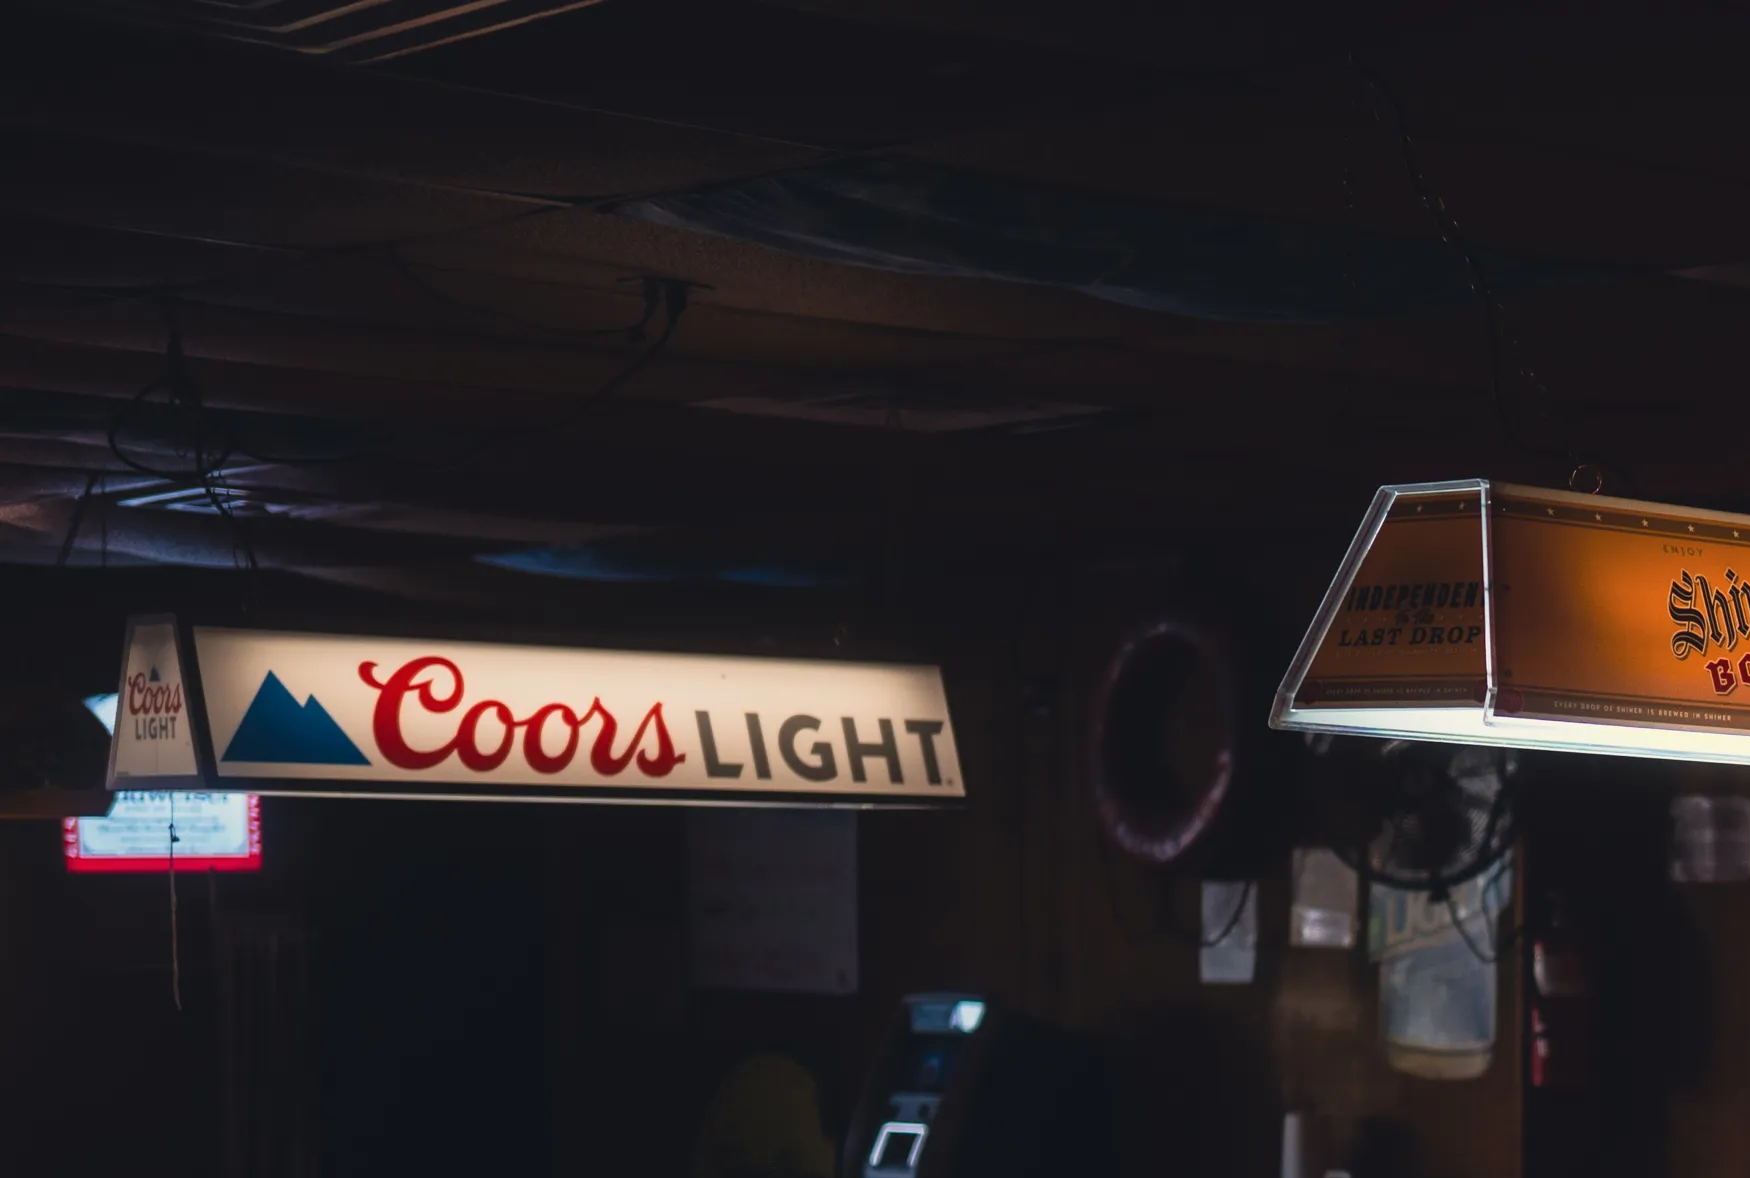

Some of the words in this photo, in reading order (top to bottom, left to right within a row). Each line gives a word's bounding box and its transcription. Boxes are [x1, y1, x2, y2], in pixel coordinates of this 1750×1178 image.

[1662, 544, 1703, 558] ENJOY
[1346, 582, 1485, 612] INDEPENDEN
[1338, 628, 1402, 647] LAST
[1409, 625, 1482, 646] DROP
[128, 672, 182, 715] Coors
[357, 656, 685, 777] Coors
[694, 709, 945, 786] LIGHT
[1580, 702, 1600, 711] DROP
[1616, 706, 1642, 715] SHINER
[1658, 709, 1689, 718] BREWED
[1704, 713, 1732, 721] SHINER
[135, 716, 177, 740] LIGHT
